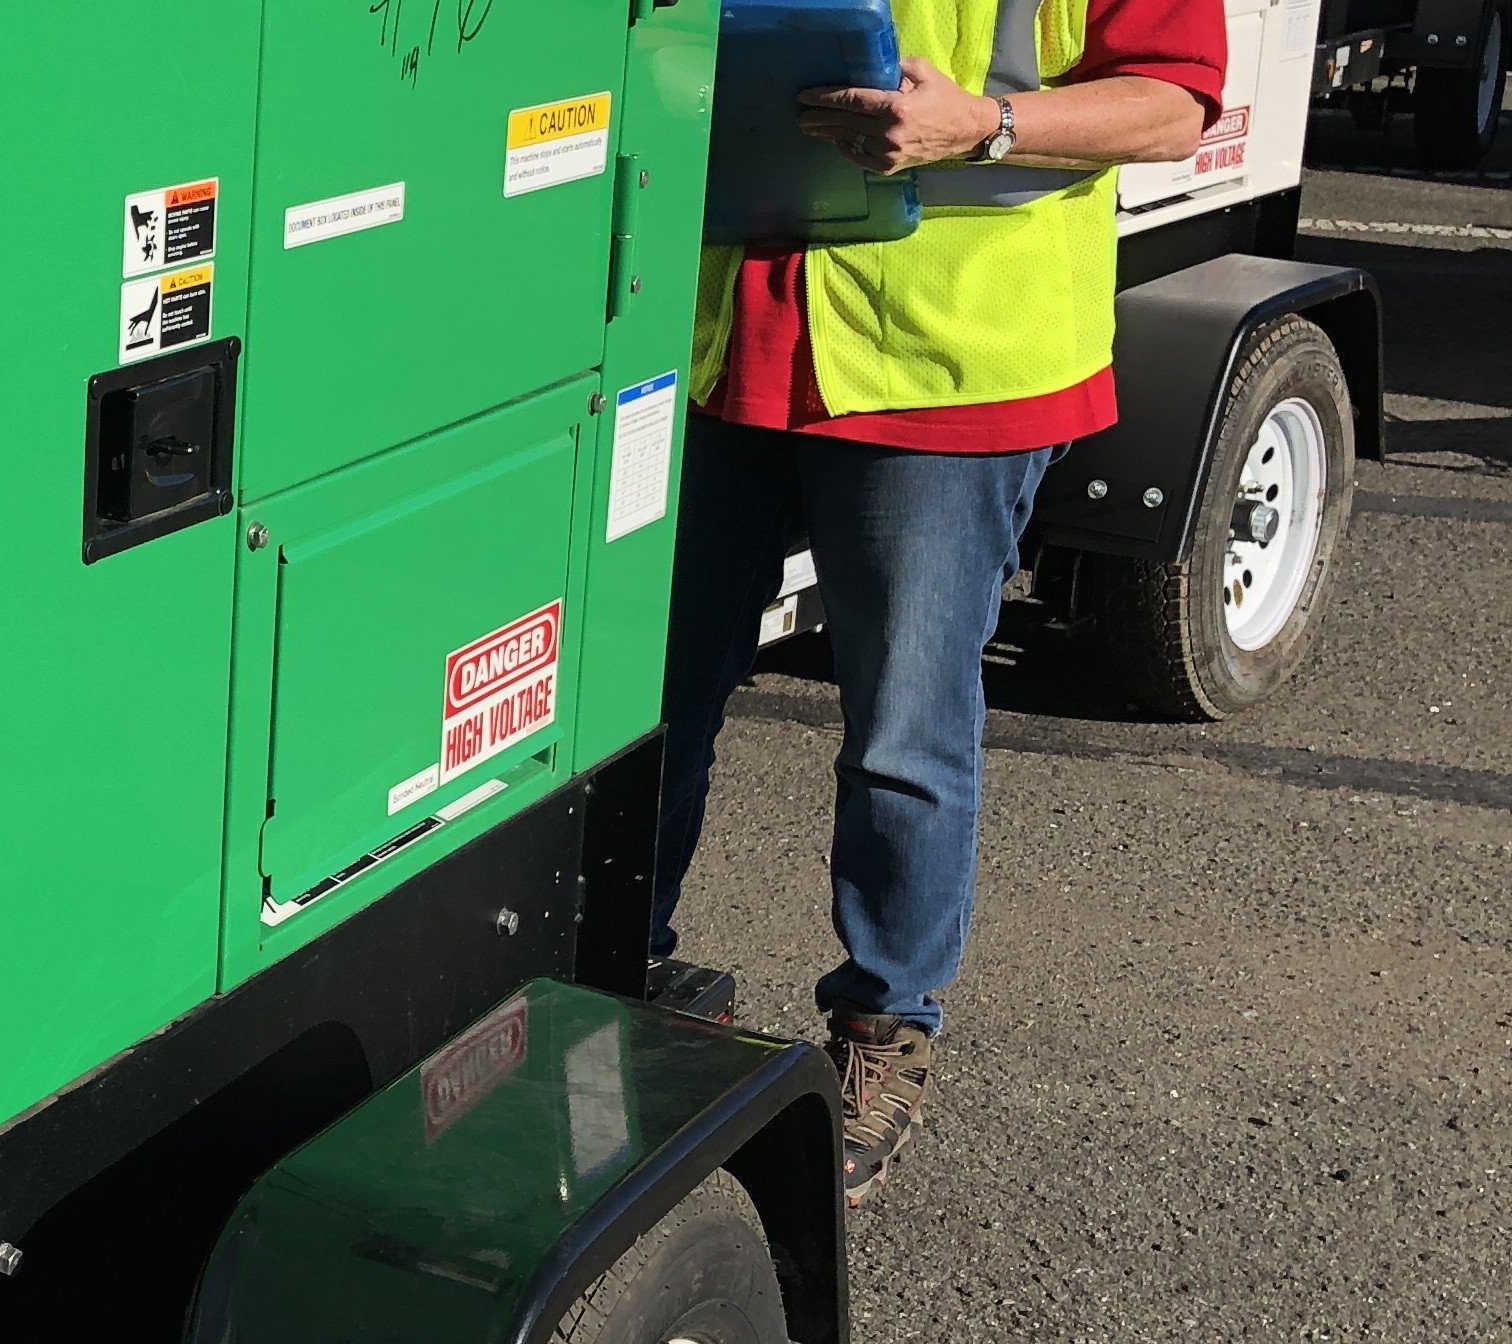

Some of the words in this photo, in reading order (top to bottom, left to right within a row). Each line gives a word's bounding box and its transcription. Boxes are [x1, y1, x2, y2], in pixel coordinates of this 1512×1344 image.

[539, 103, 597, 136] CAUTION
[181, 187, 212, 202] WARNING
[178, 274, 204, 287] CAUTION
[460, 625, 546, 696] DANGER
[445, 711, 485, 773] HIGH
[489, 674, 554, 747] VOLTAGE
